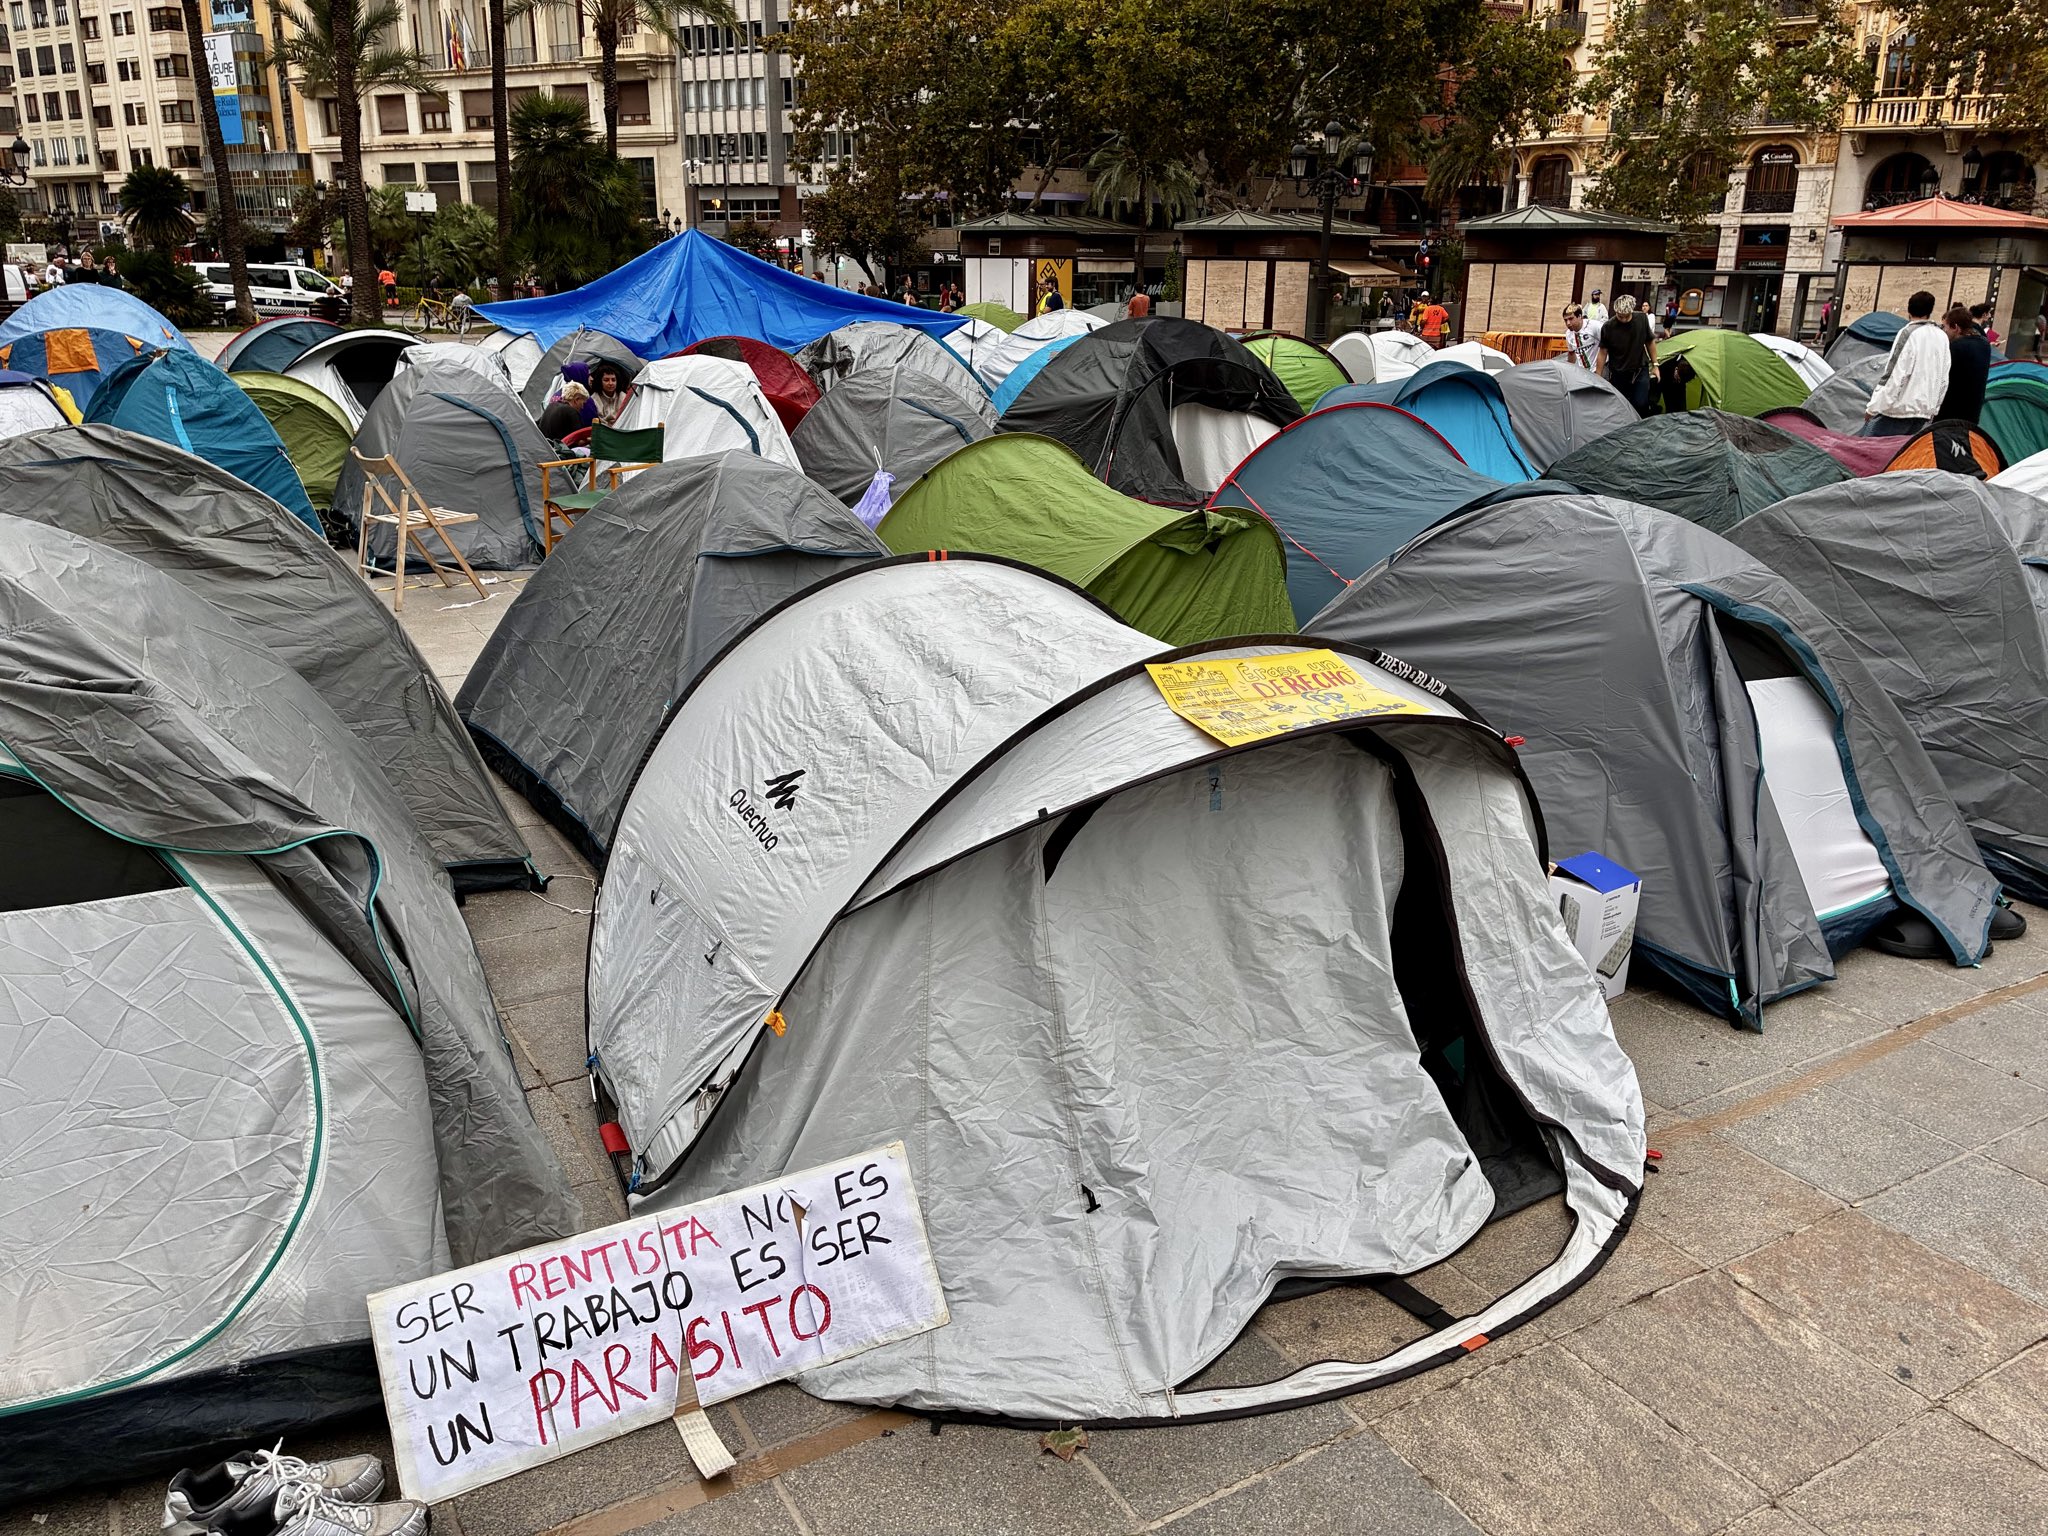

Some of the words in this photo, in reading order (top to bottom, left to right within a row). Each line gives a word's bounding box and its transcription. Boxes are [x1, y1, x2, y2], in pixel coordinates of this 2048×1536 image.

[203, 39, 216, 51] OLT
[212, 51, 219, 62] A
[224, 74, 235, 86] TU
[265, 298, 282, 306] PLV
[1237, 662, 1300, 682] Érase
[1307, 660, 1338, 672] un
[1375, 651, 1412, 679] FRESH
[1409, 670, 1417, 680] &
[1251, 670, 1356, 699] DERECHO
[730, 788, 779, 852] Quechua
[396, 1282, 484, 1344] SER
[508, 1215, 722, 1310] RENTISTA
[834, 1163, 889, 1212] ES
[409, 1339, 480, 1400] UN
[497, 1271, 693, 1373] TRABAJO
[730, 1241, 786, 1294] ES
[811, 1211, 892, 1267] SER
[427, 1401, 494, 1466] UN
[529, 1283, 831, 1446] PARASITO
